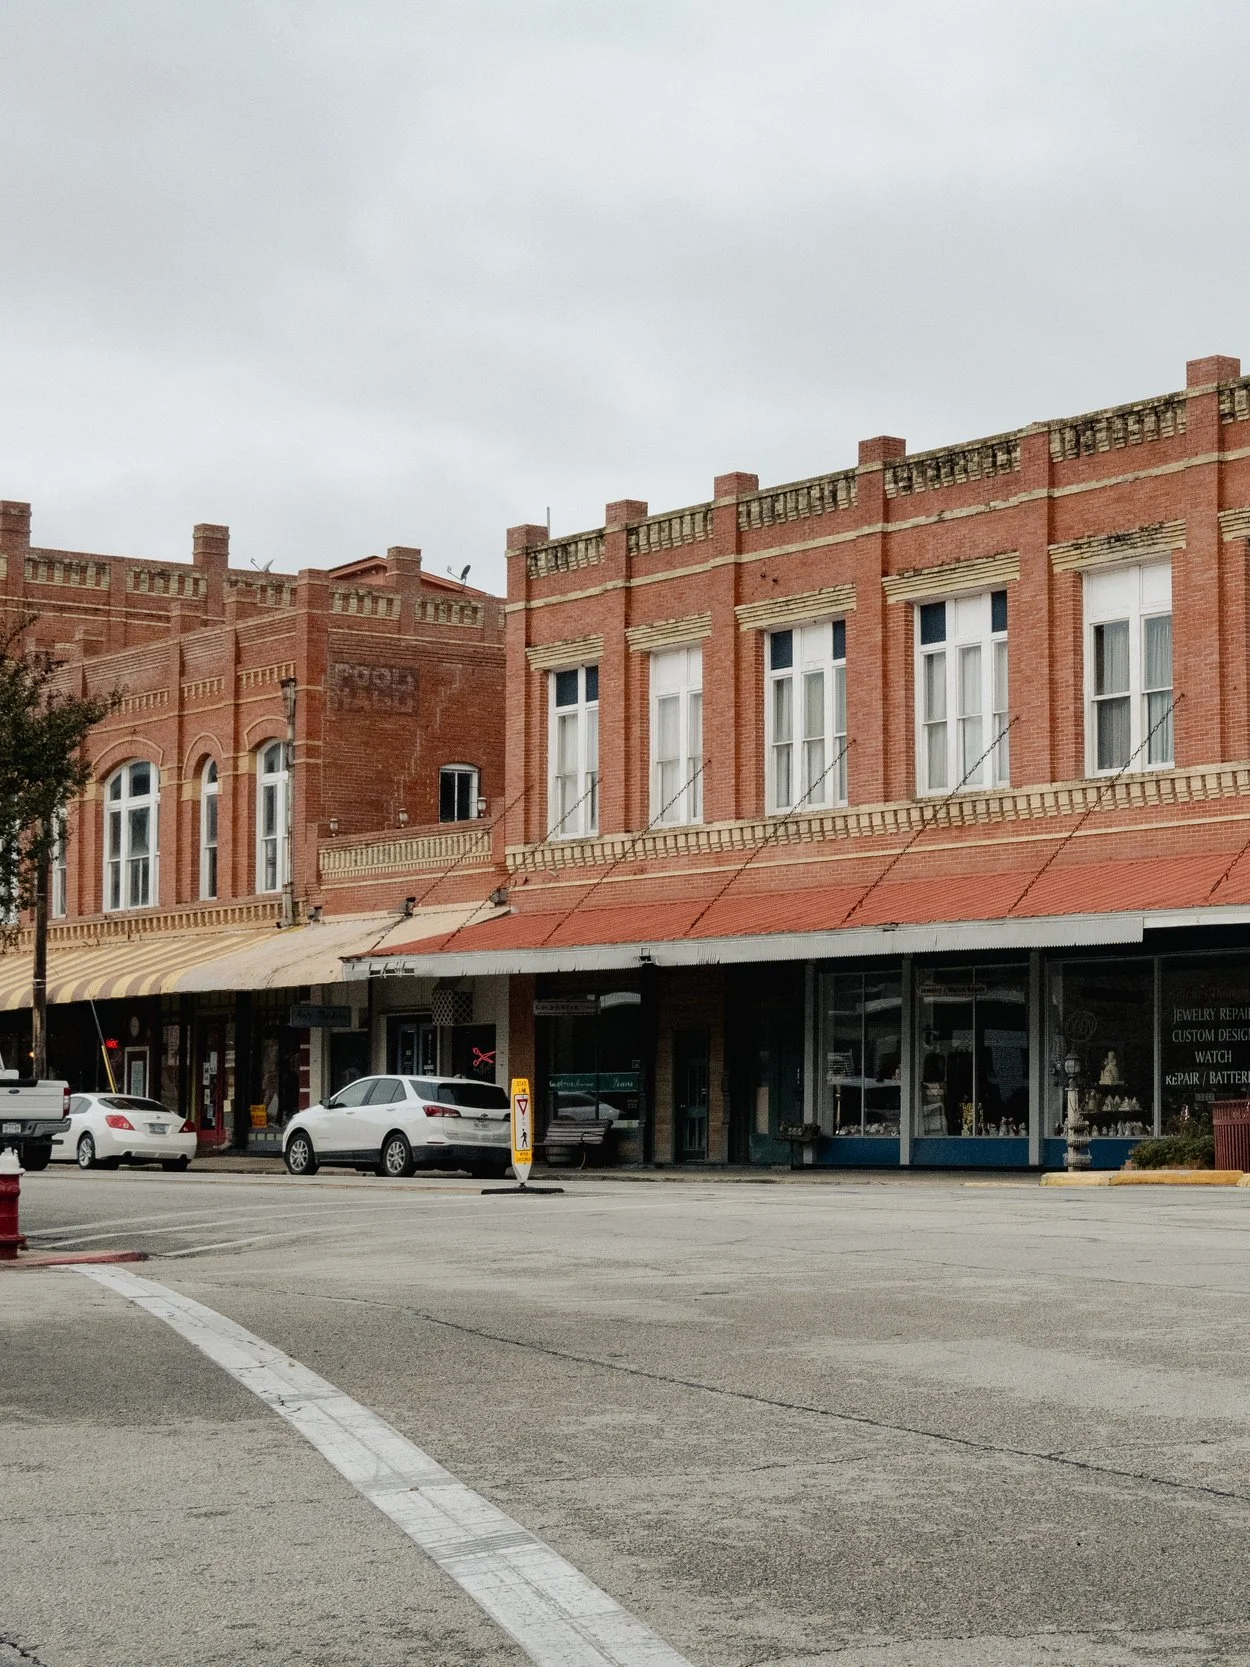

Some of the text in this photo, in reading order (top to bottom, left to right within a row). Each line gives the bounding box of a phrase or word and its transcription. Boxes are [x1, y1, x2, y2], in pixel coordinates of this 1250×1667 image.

[1173, 1005, 1217, 1025] JEWELRY
[1172, 1029, 1215, 1042] CUSTOM
[1194, 1050, 1233, 1063] WATCH
